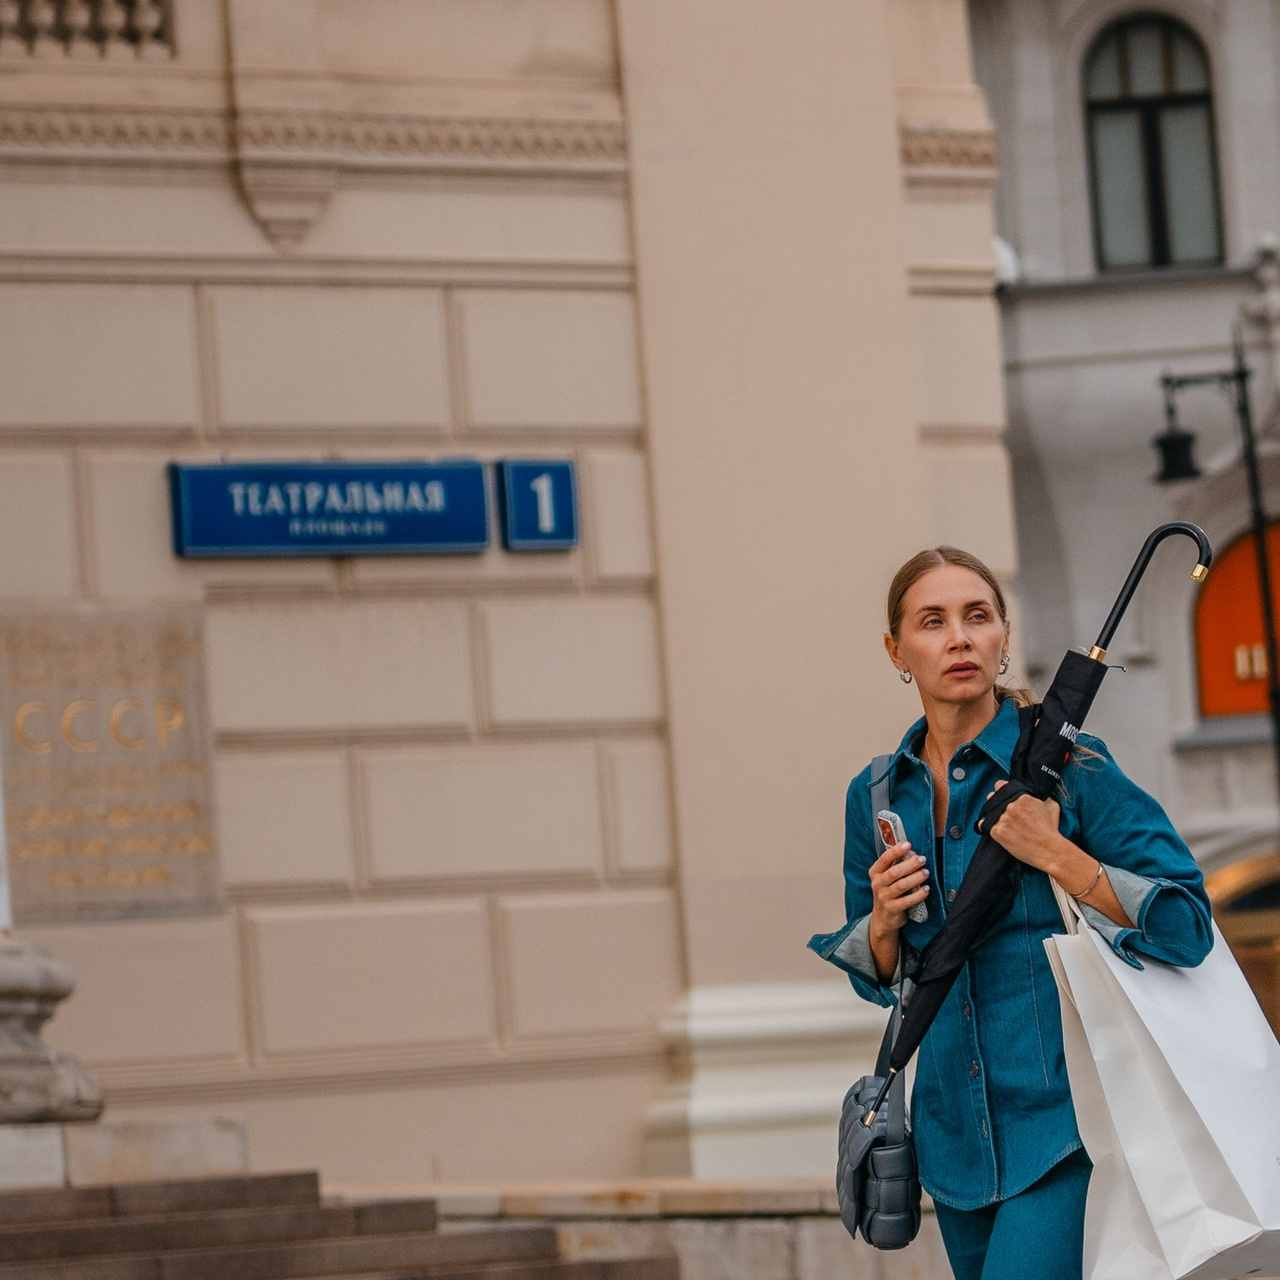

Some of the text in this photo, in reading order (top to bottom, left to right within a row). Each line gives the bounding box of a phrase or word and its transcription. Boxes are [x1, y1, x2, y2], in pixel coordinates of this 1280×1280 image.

[228, 481, 446, 516] ТЕАТРАЛЬНАЯ
[530, 473, 556, 534] 1
[13, 695, 186, 754] СССР
[1059, 721, 1079, 744] MOS
